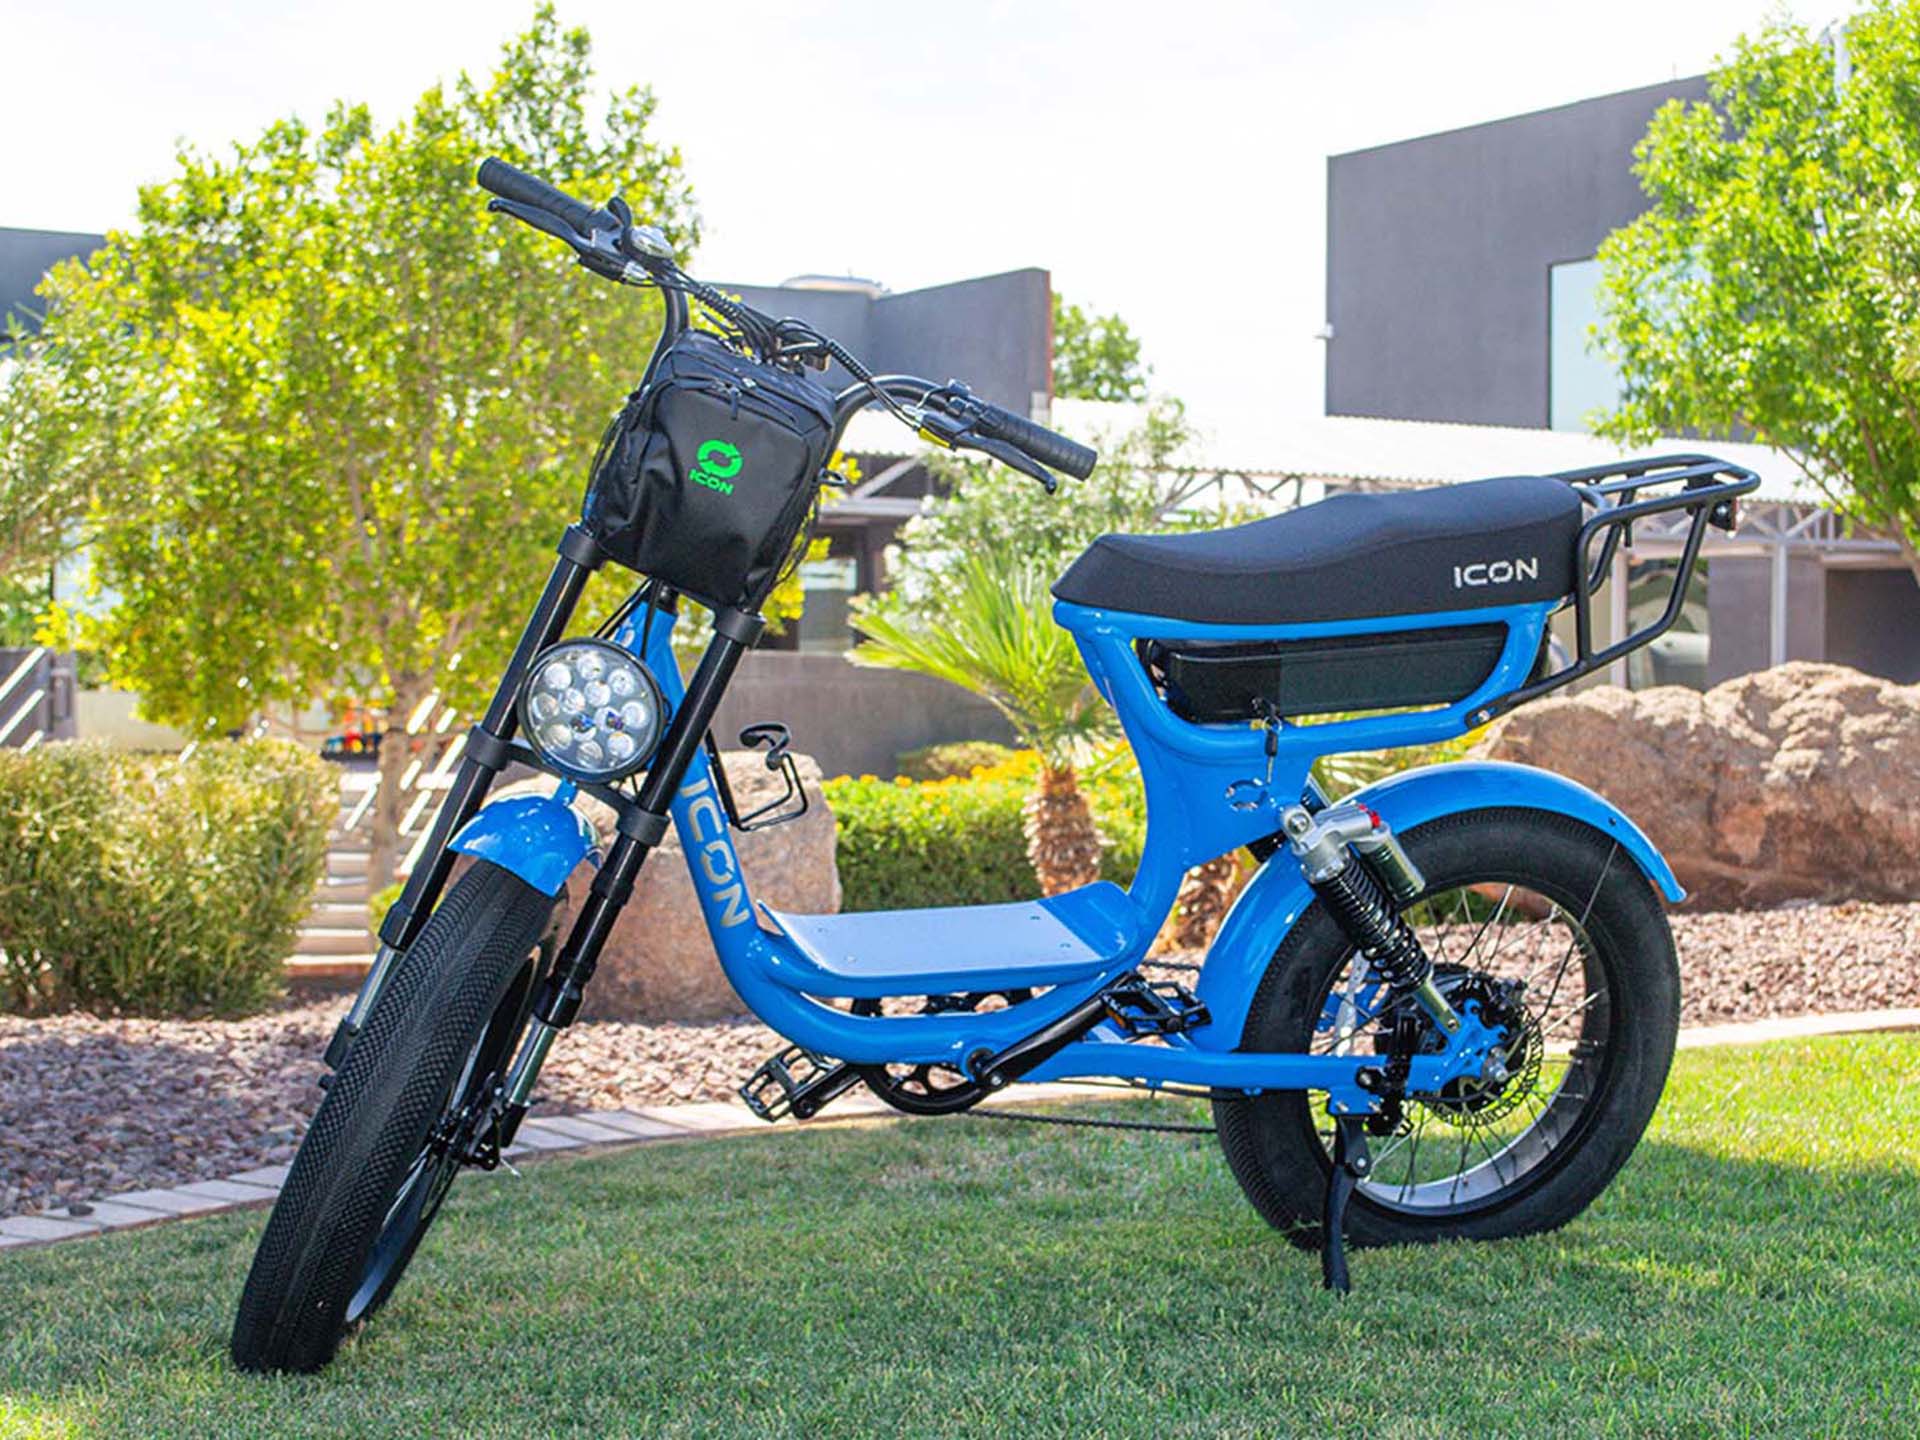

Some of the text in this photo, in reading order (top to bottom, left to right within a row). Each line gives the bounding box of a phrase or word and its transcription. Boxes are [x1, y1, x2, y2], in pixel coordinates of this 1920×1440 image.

[689, 468, 733, 495] ICON
[1453, 557, 1538, 588] ICON
[680, 778, 749, 927] ICON
